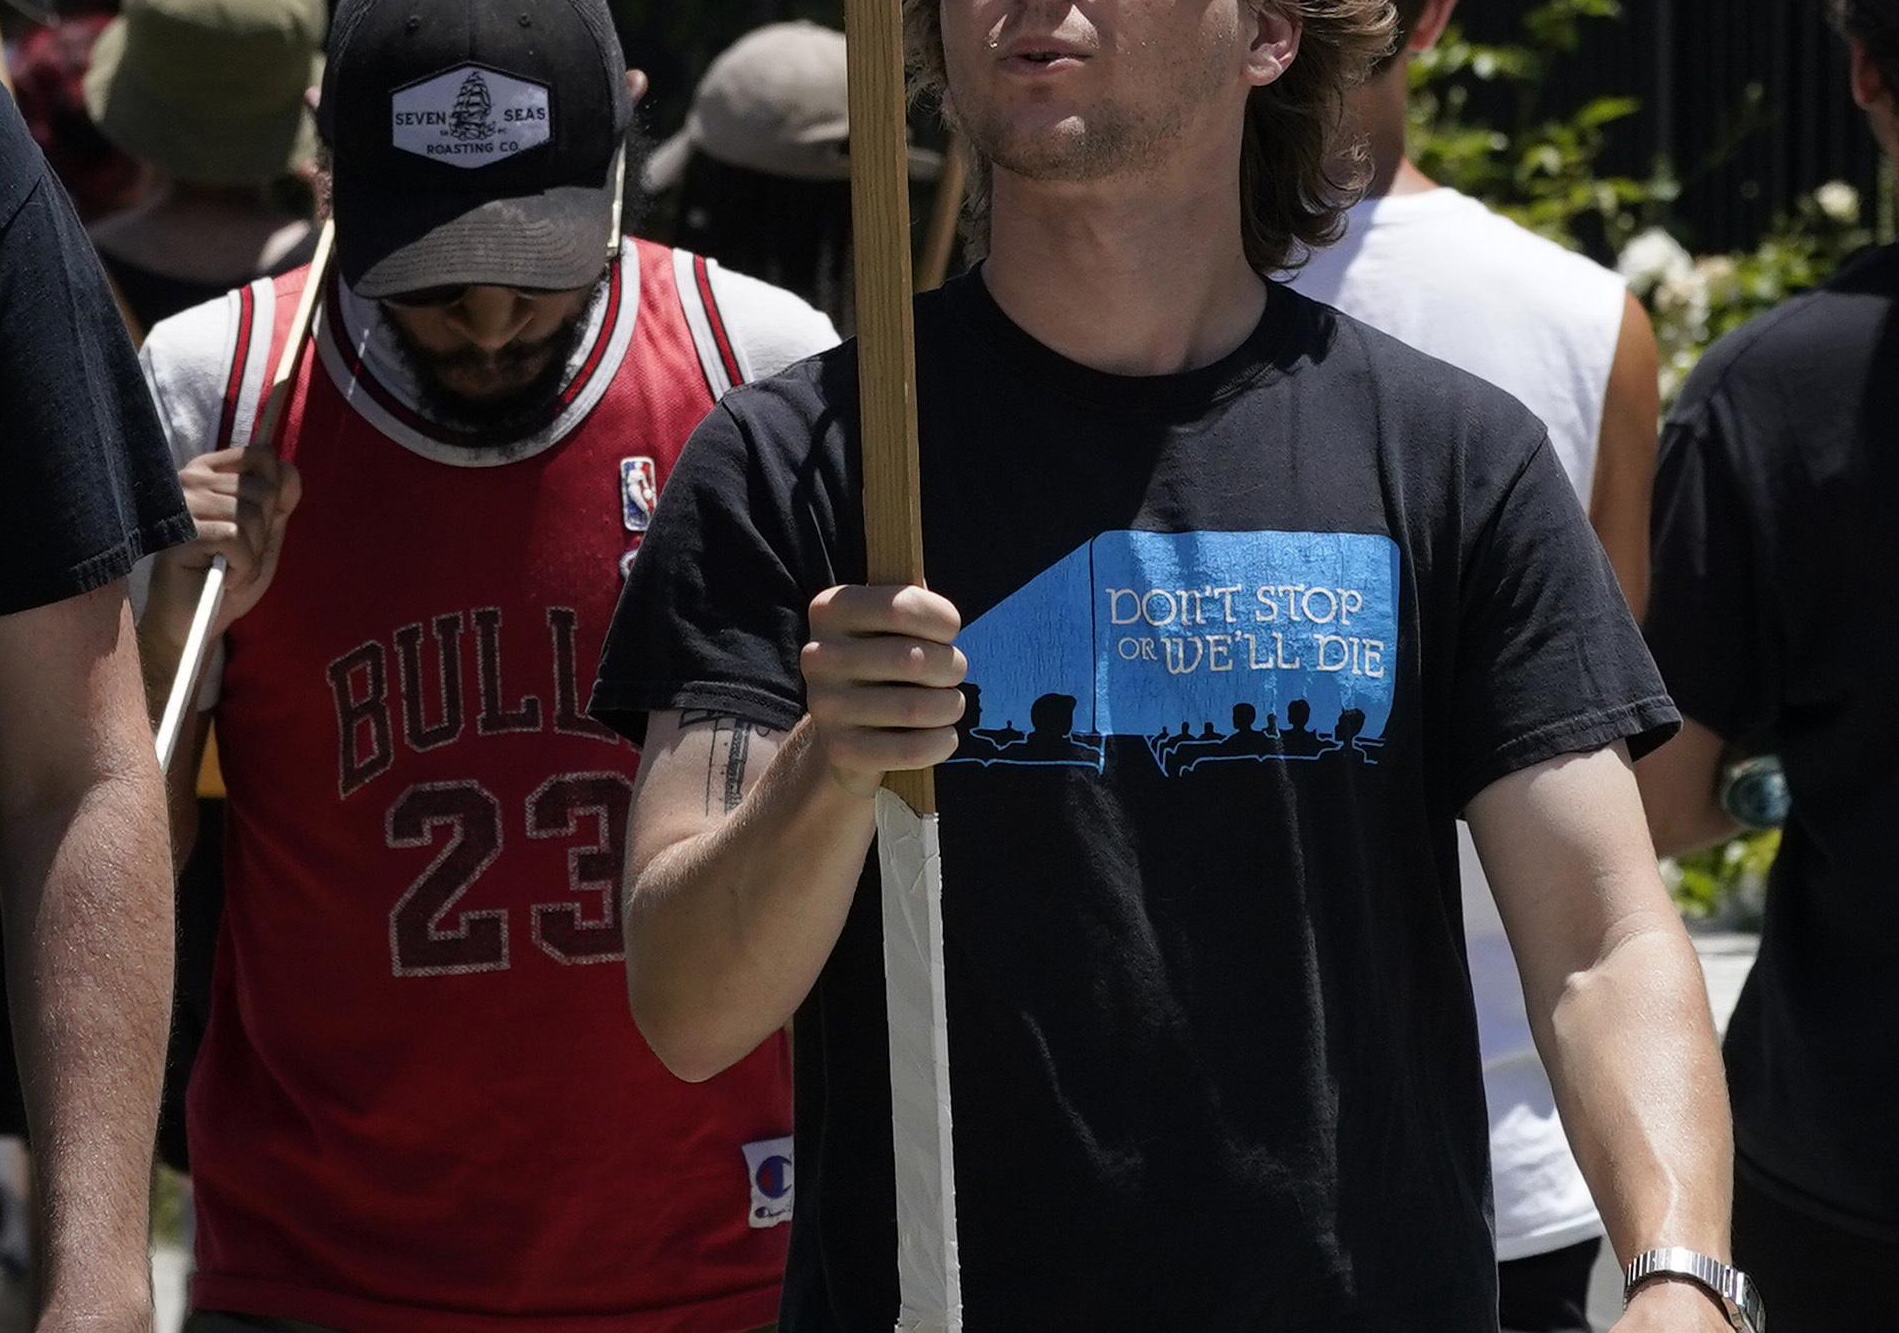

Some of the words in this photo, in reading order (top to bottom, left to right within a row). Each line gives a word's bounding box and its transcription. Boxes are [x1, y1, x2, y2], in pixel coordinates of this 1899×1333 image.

[395, 111, 447, 126] SEVEN
[503, 107, 546, 122] SEAS
[426, 142, 494, 155] ROASTING
[1255, 583, 1363, 625] STOP
[1117, 637, 1158, 661] OR
[1161, 630, 1301, 675] WE'LL
[1313, 633, 1385, 679] DIE
[326, 605, 643, 801] BULL
[385, 769, 639, 979] 23
